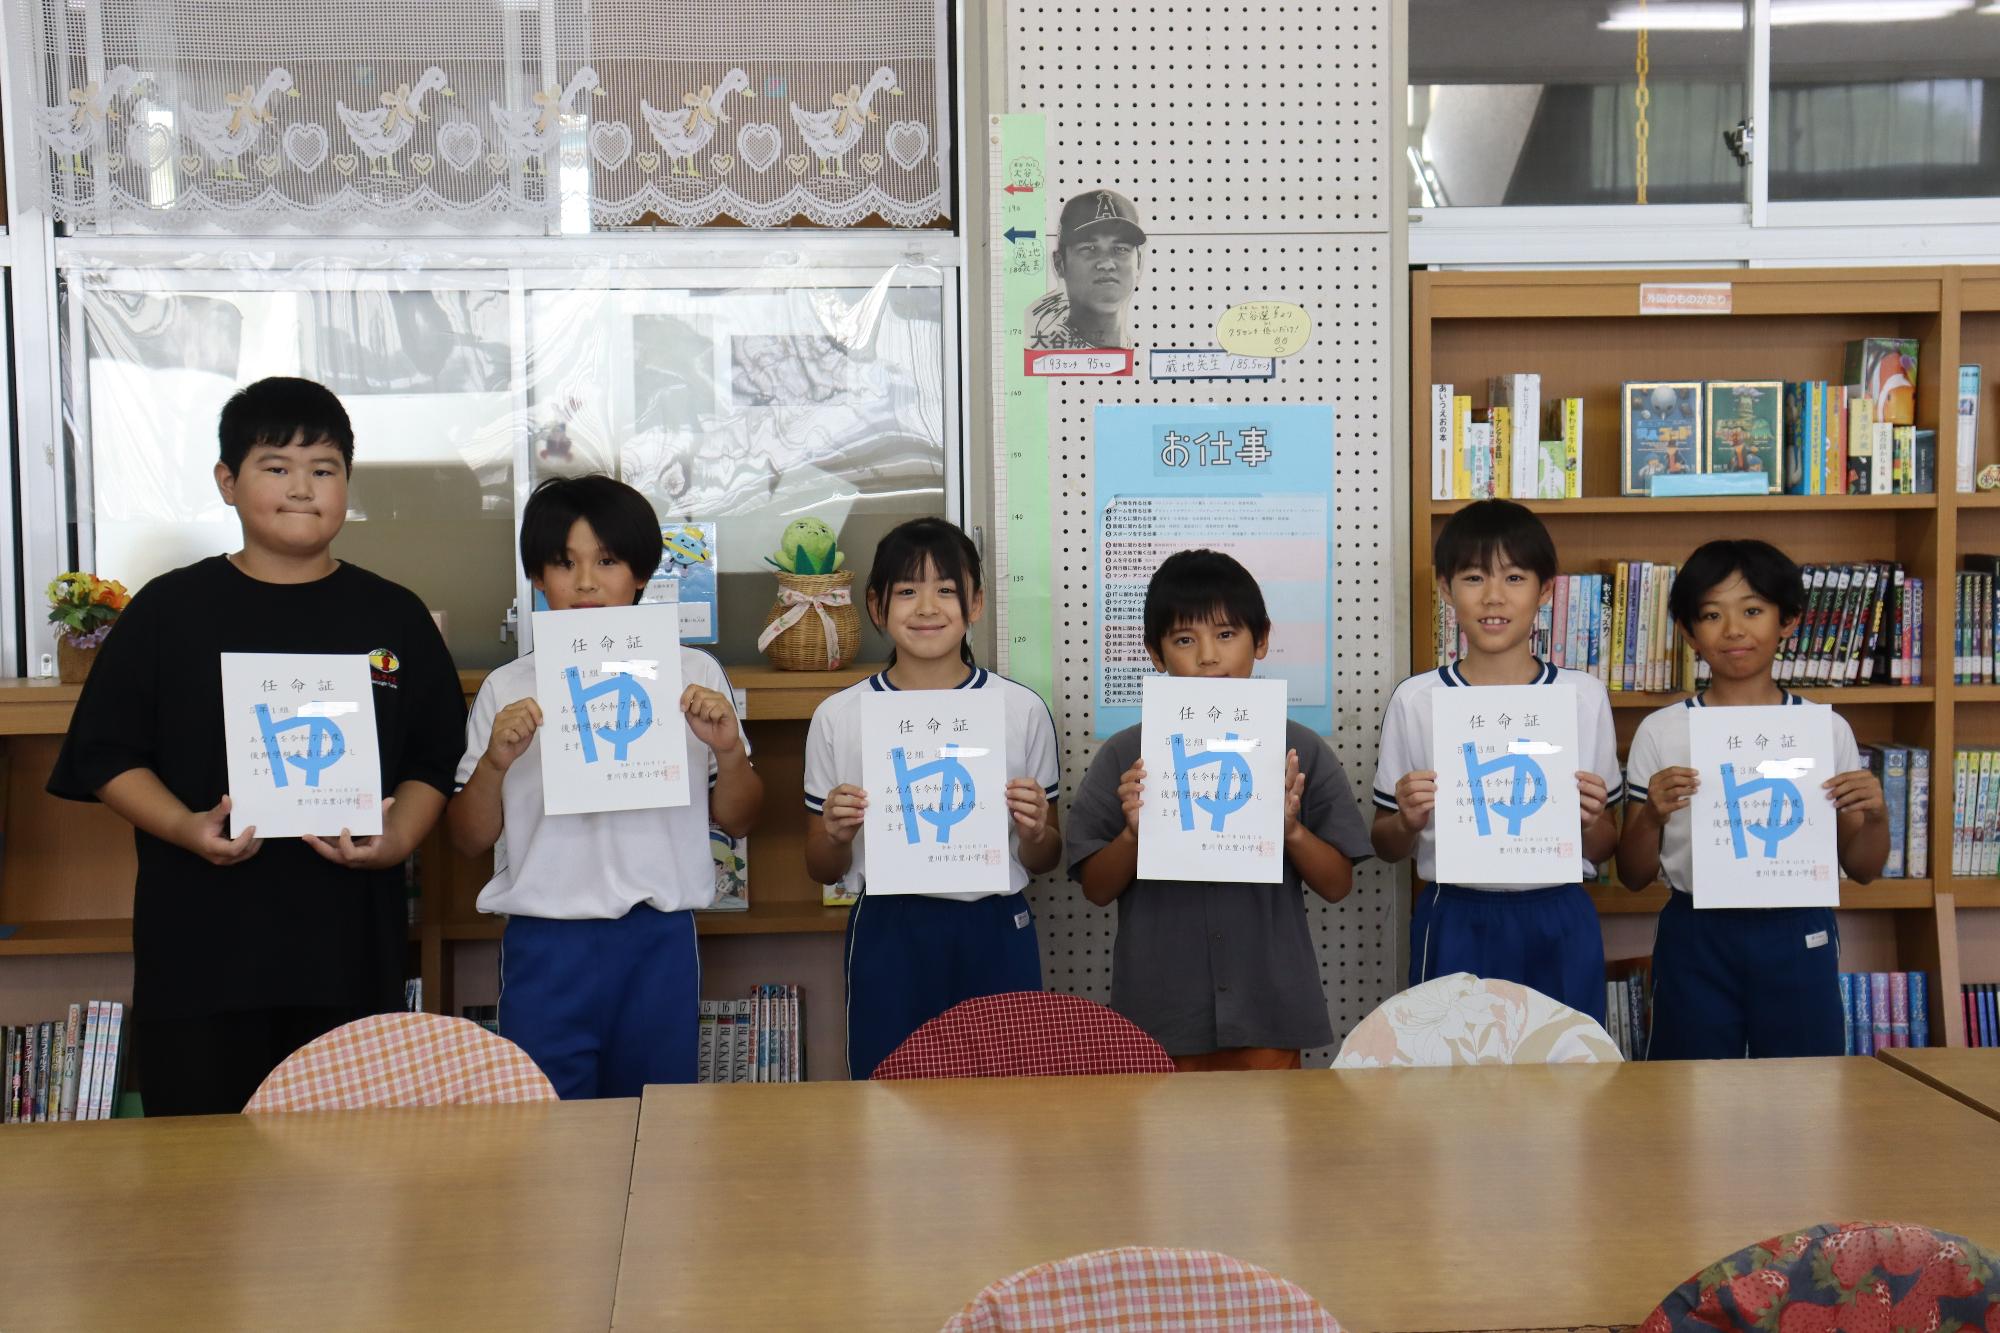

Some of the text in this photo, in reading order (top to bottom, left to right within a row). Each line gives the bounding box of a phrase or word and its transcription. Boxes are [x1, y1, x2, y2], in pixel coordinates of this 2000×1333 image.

[1096, 195, 1118, 219] A
[1439, 384, 1447, 442] あいうえおの本
[1161, 426, 1272, 468] お仕事
[571, 635, 643, 652] 任命証
[261, 678, 335, 693] 任命証
[1179, 705, 1249, 723] 任命証
[1469, 713, 1540, 730] 任命証
[899, 717, 969, 735] 任命証
[1727, 733, 1797, 750] 任命証
[704, 1002, 710, 1012] 15
[723, 1002, 729, 1012] 16
[740, 1002, 746, 1011] 17
